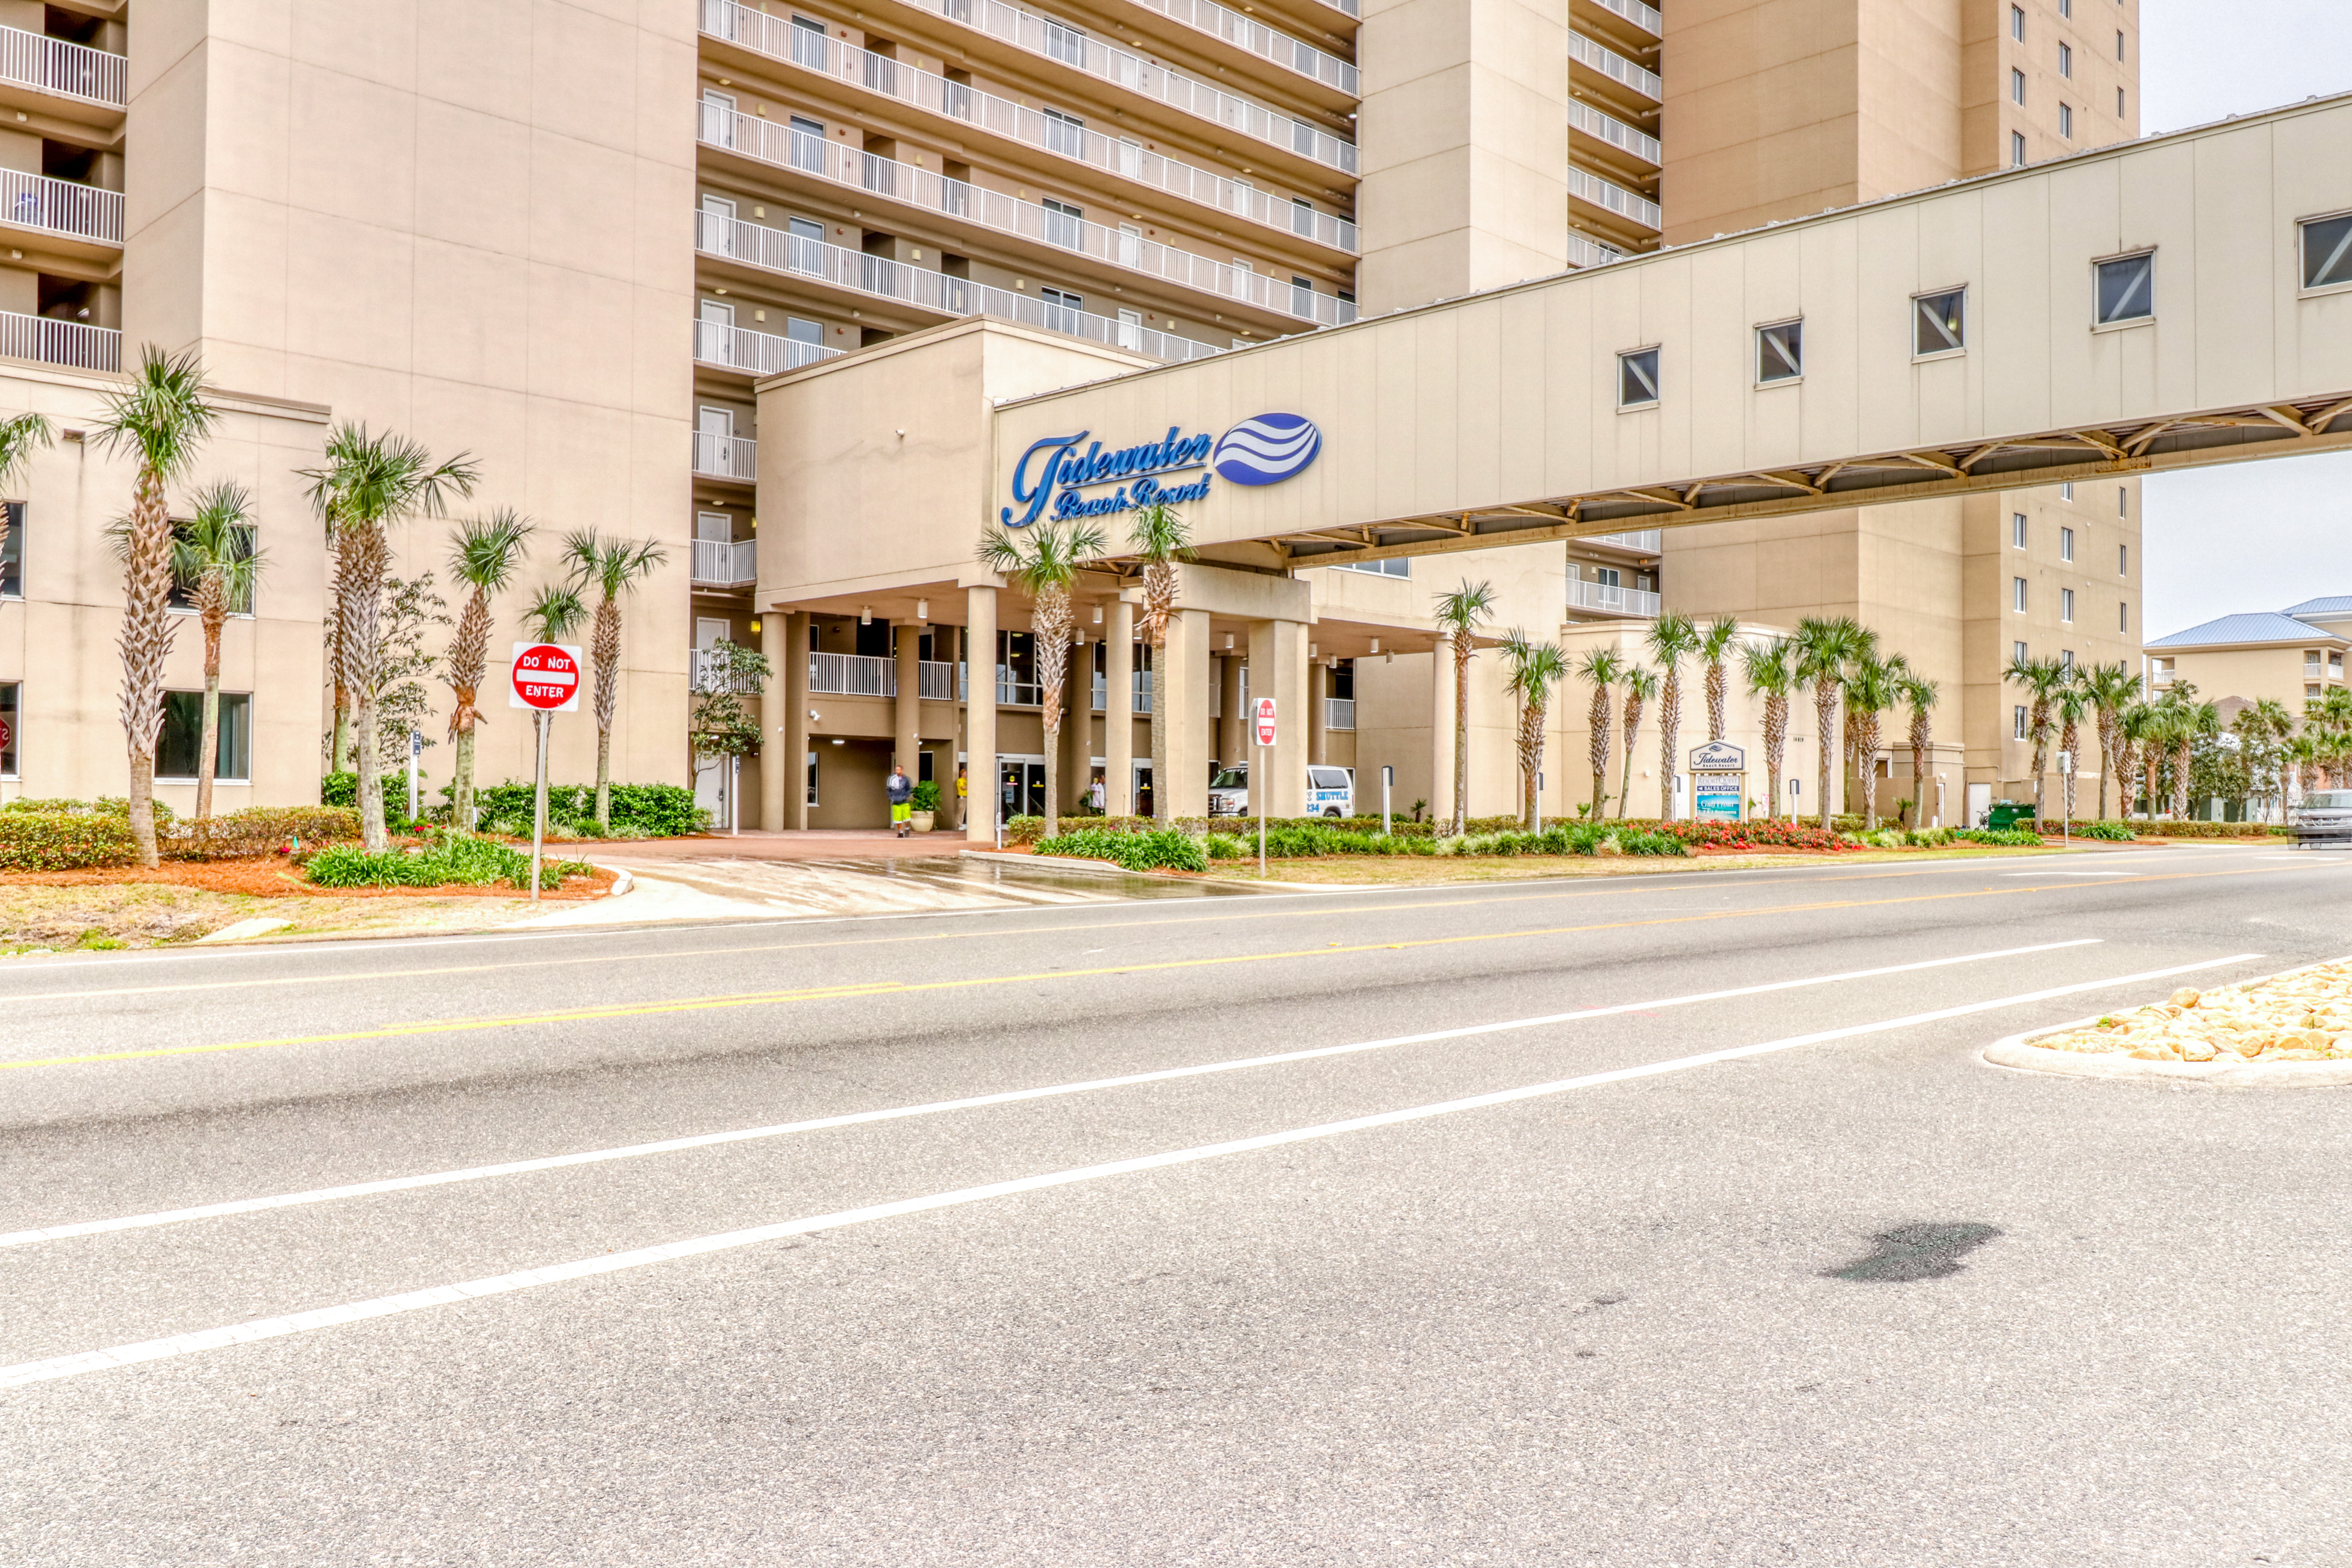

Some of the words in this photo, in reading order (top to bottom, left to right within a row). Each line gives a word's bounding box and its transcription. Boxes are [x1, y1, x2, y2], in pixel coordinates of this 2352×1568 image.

[1001, 426, 1213, 528] Tidewater
[1049, 487, 1128, 521] Beach
[1130, 473, 1213, 507] Resort
[523, 656, 539, 667] DO
[548, 657, 571, 670] NOT
[526, 685, 564, 698] ENTER
[1260, 728, 1272, 736] ENTER
[1694, 752, 1737, 765] Tidewater
[1316, 791, 1349, 801] SHUTTLE
